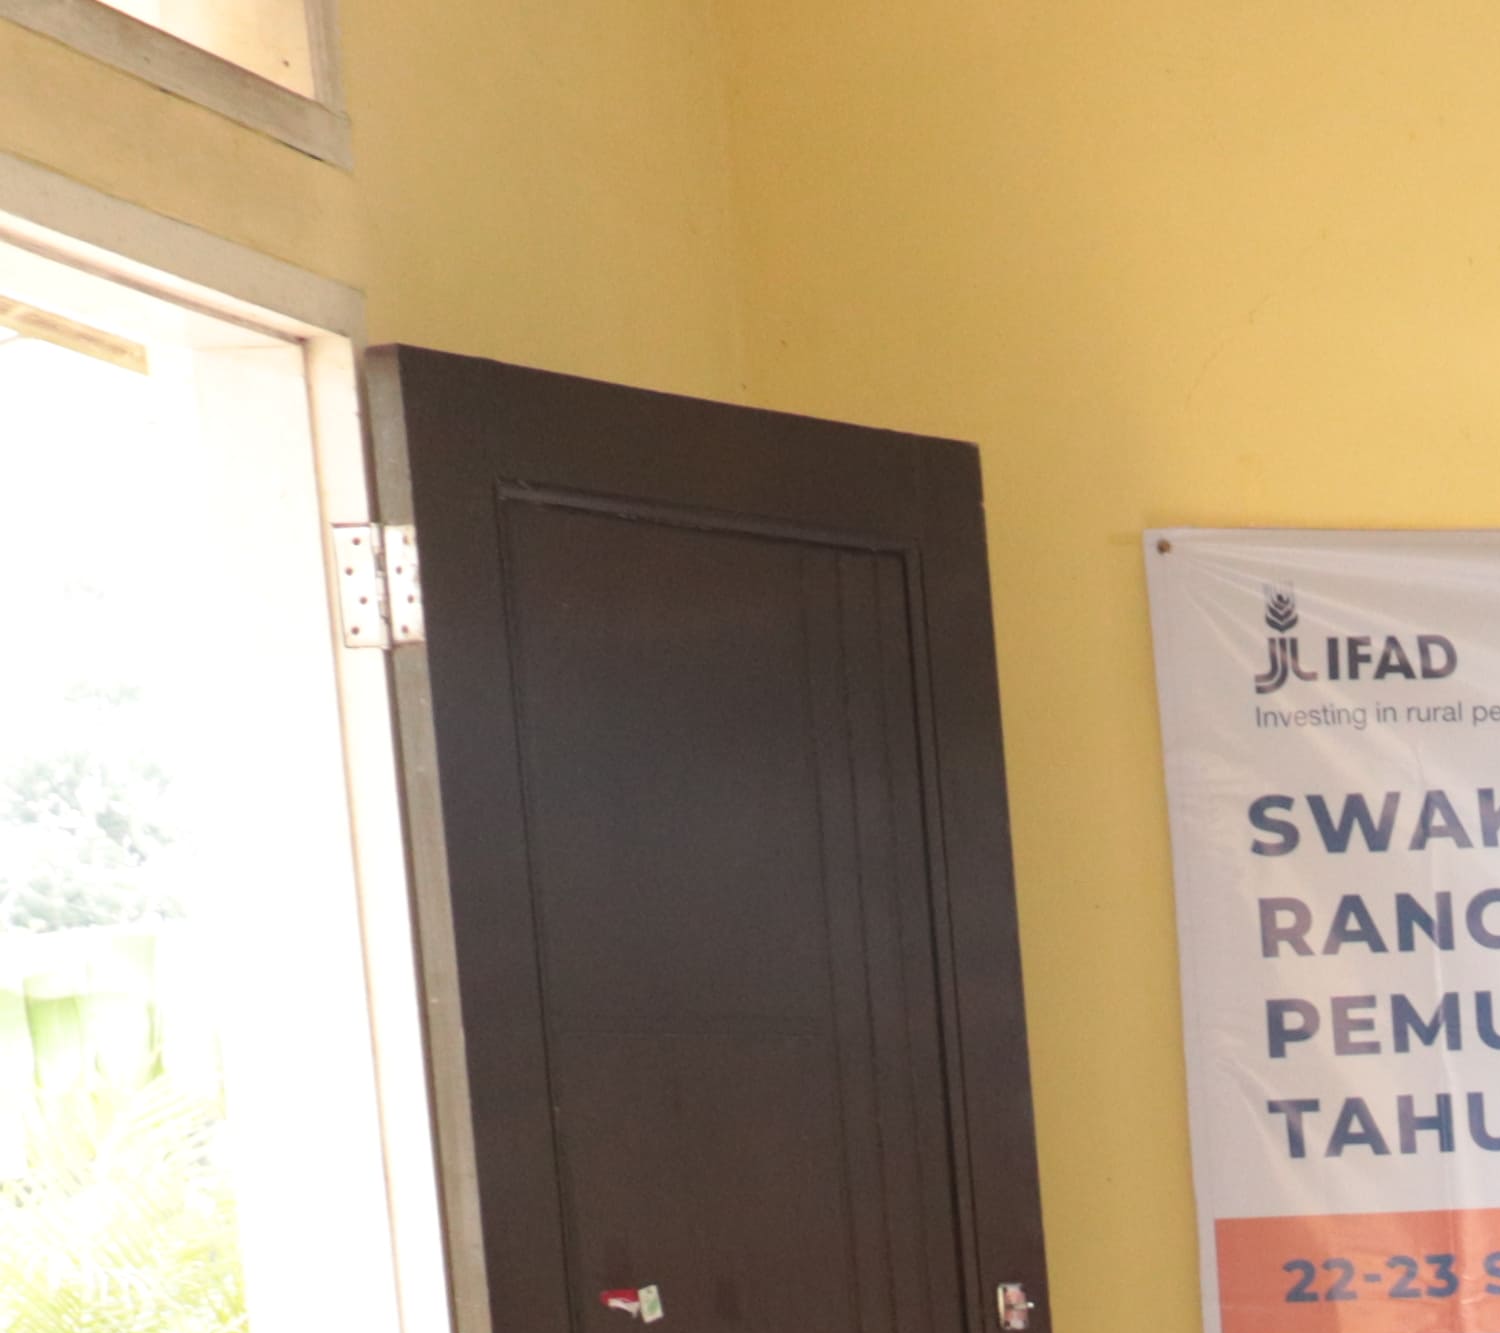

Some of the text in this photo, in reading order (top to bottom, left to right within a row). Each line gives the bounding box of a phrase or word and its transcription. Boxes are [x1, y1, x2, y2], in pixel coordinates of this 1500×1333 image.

[1327, 634, 1458, 680] IFAD
[1255, 704, 1367, 730] Investing
[1376, 703, 1398, 724] in
[1406, 701, 1463, 724] rural
[1282, 1252, 1461, 1305] 22-23
